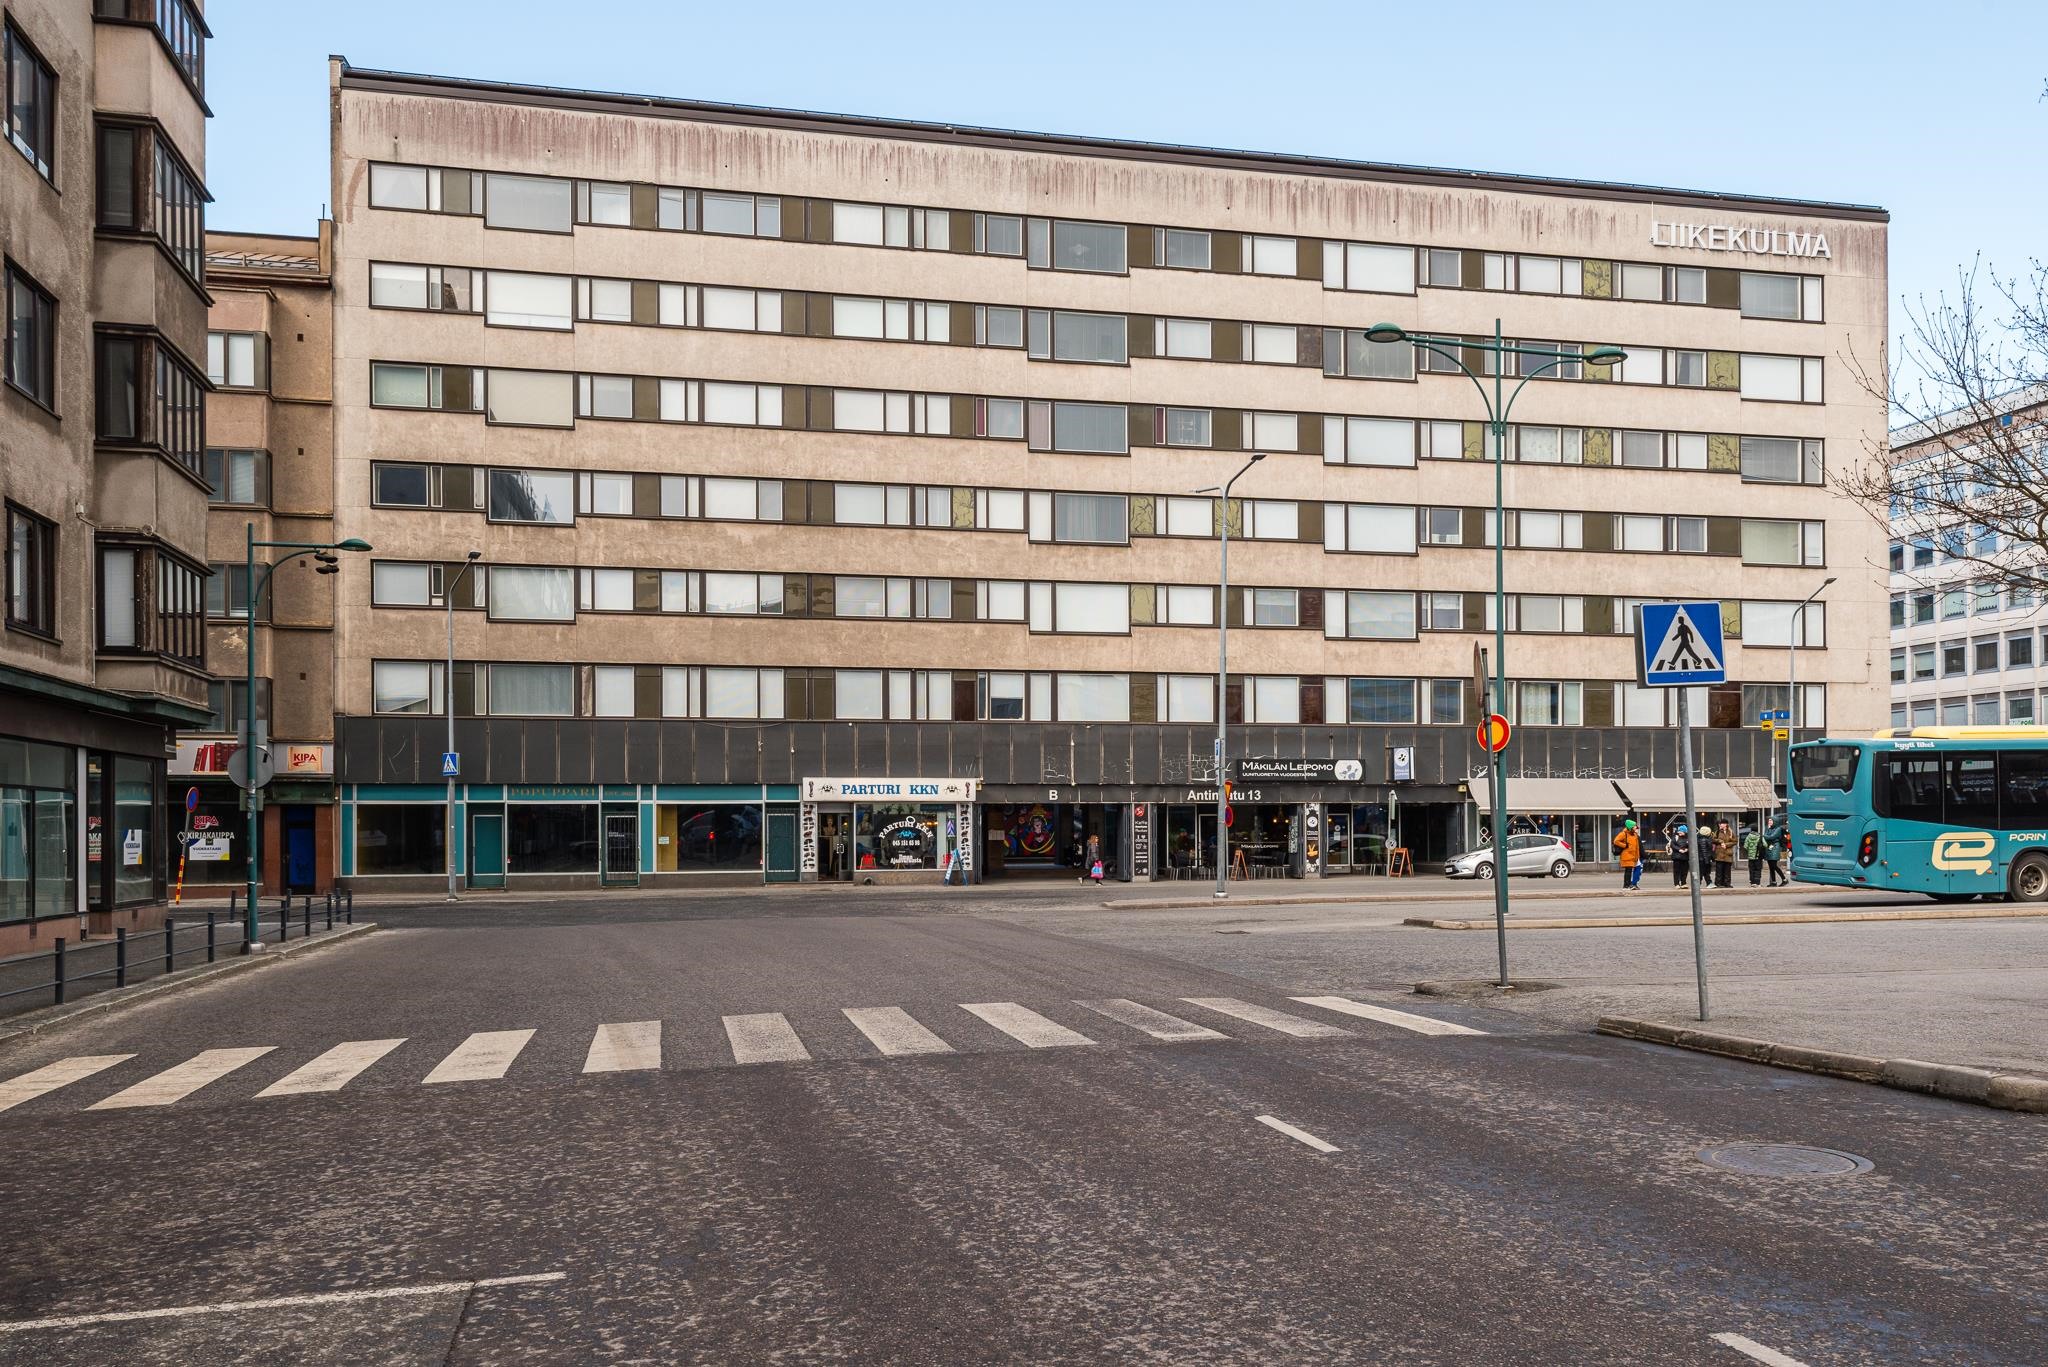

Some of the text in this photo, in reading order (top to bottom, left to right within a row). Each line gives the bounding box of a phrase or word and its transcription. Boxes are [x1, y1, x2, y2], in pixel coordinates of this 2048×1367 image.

[1652, 221, 1832, 260] LIIKEKULMA
[293, 753, 317, 762] KIPA
[1242, 761, 1334, 771] MÄKILÄN LEIPOMO
[841, 784, 940, 795] PARTURI KKN
[1049, 789, 1059, 801] B
[1187, 789, 1262, 801] Antinatu 13
[879, 820, 914, 839] PARTURI
[187, 831, 235, 840] KIRJAKAUPPA
[2008, 833, 2046, 842] PORIN
